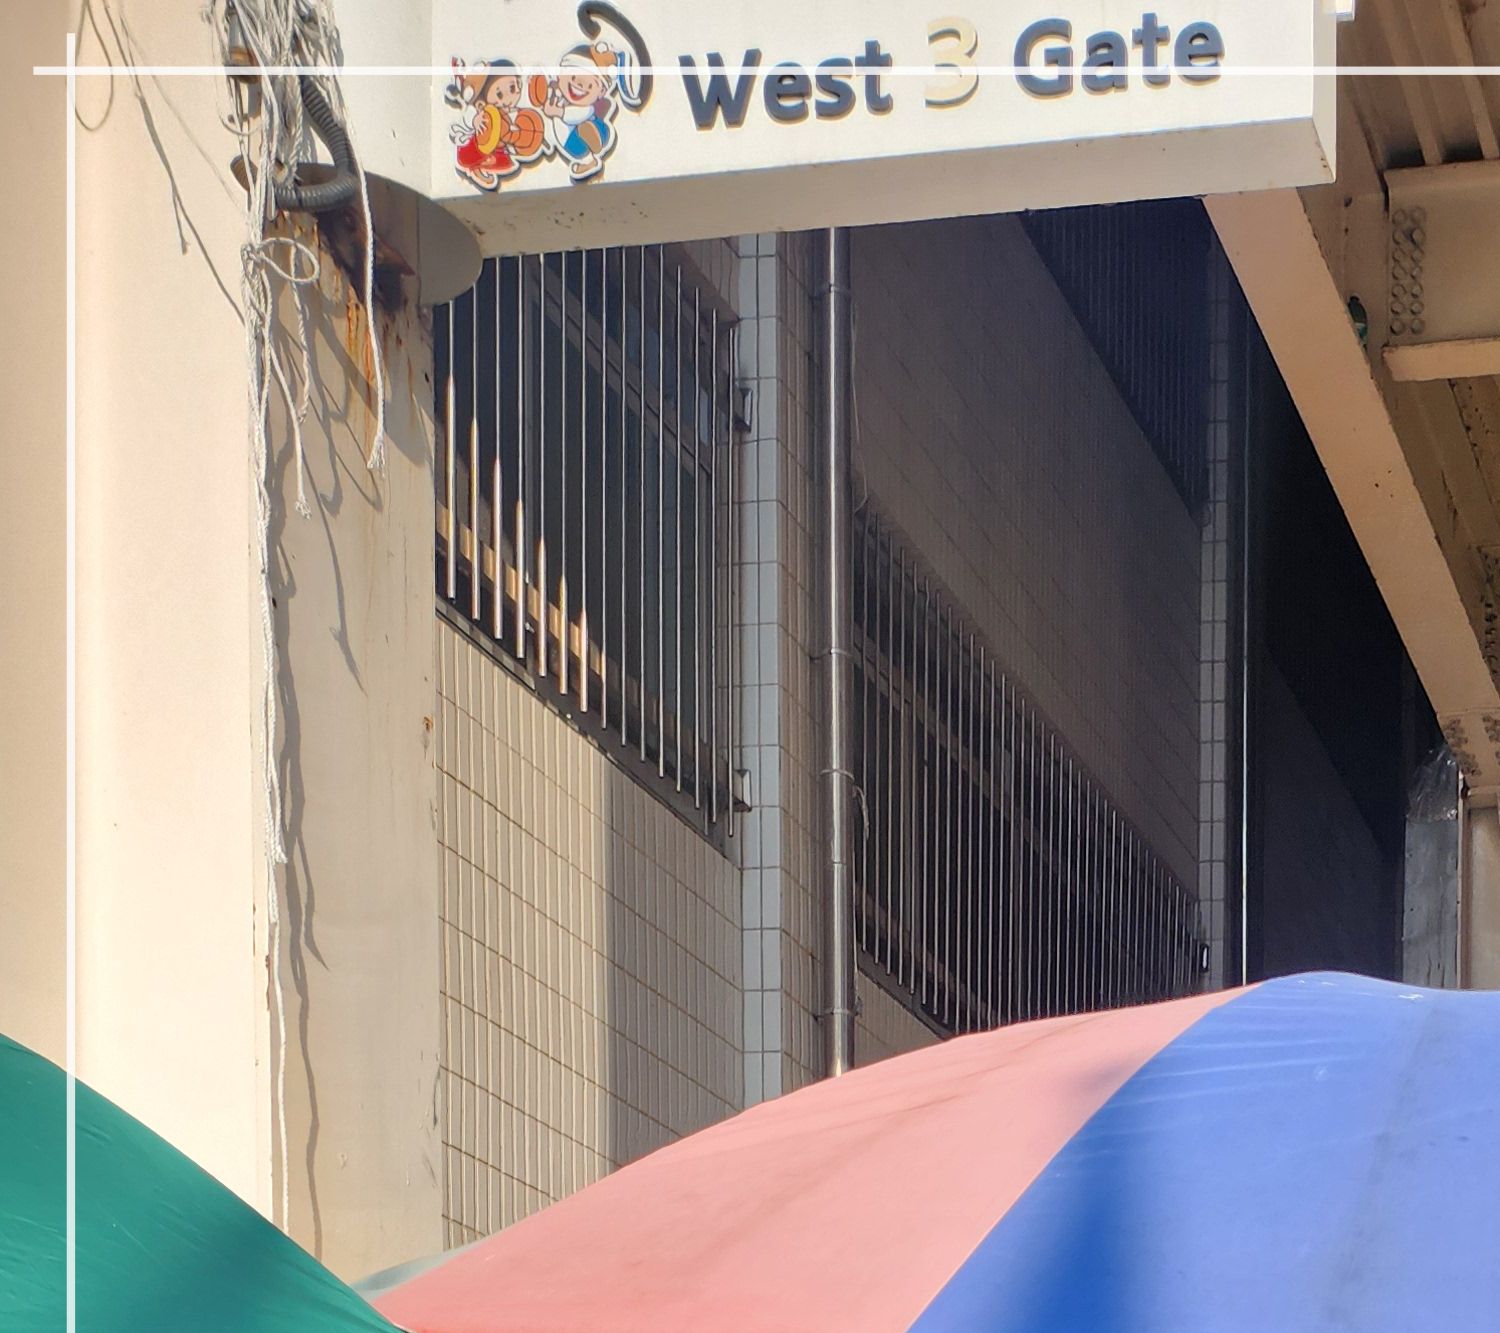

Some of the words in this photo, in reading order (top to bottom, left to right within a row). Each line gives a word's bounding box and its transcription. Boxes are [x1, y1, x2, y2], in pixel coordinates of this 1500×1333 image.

[679, 39, 894, 130] West
[925, 17, 978, 108] 3
[1014, 11, 1225, 97] Gate
